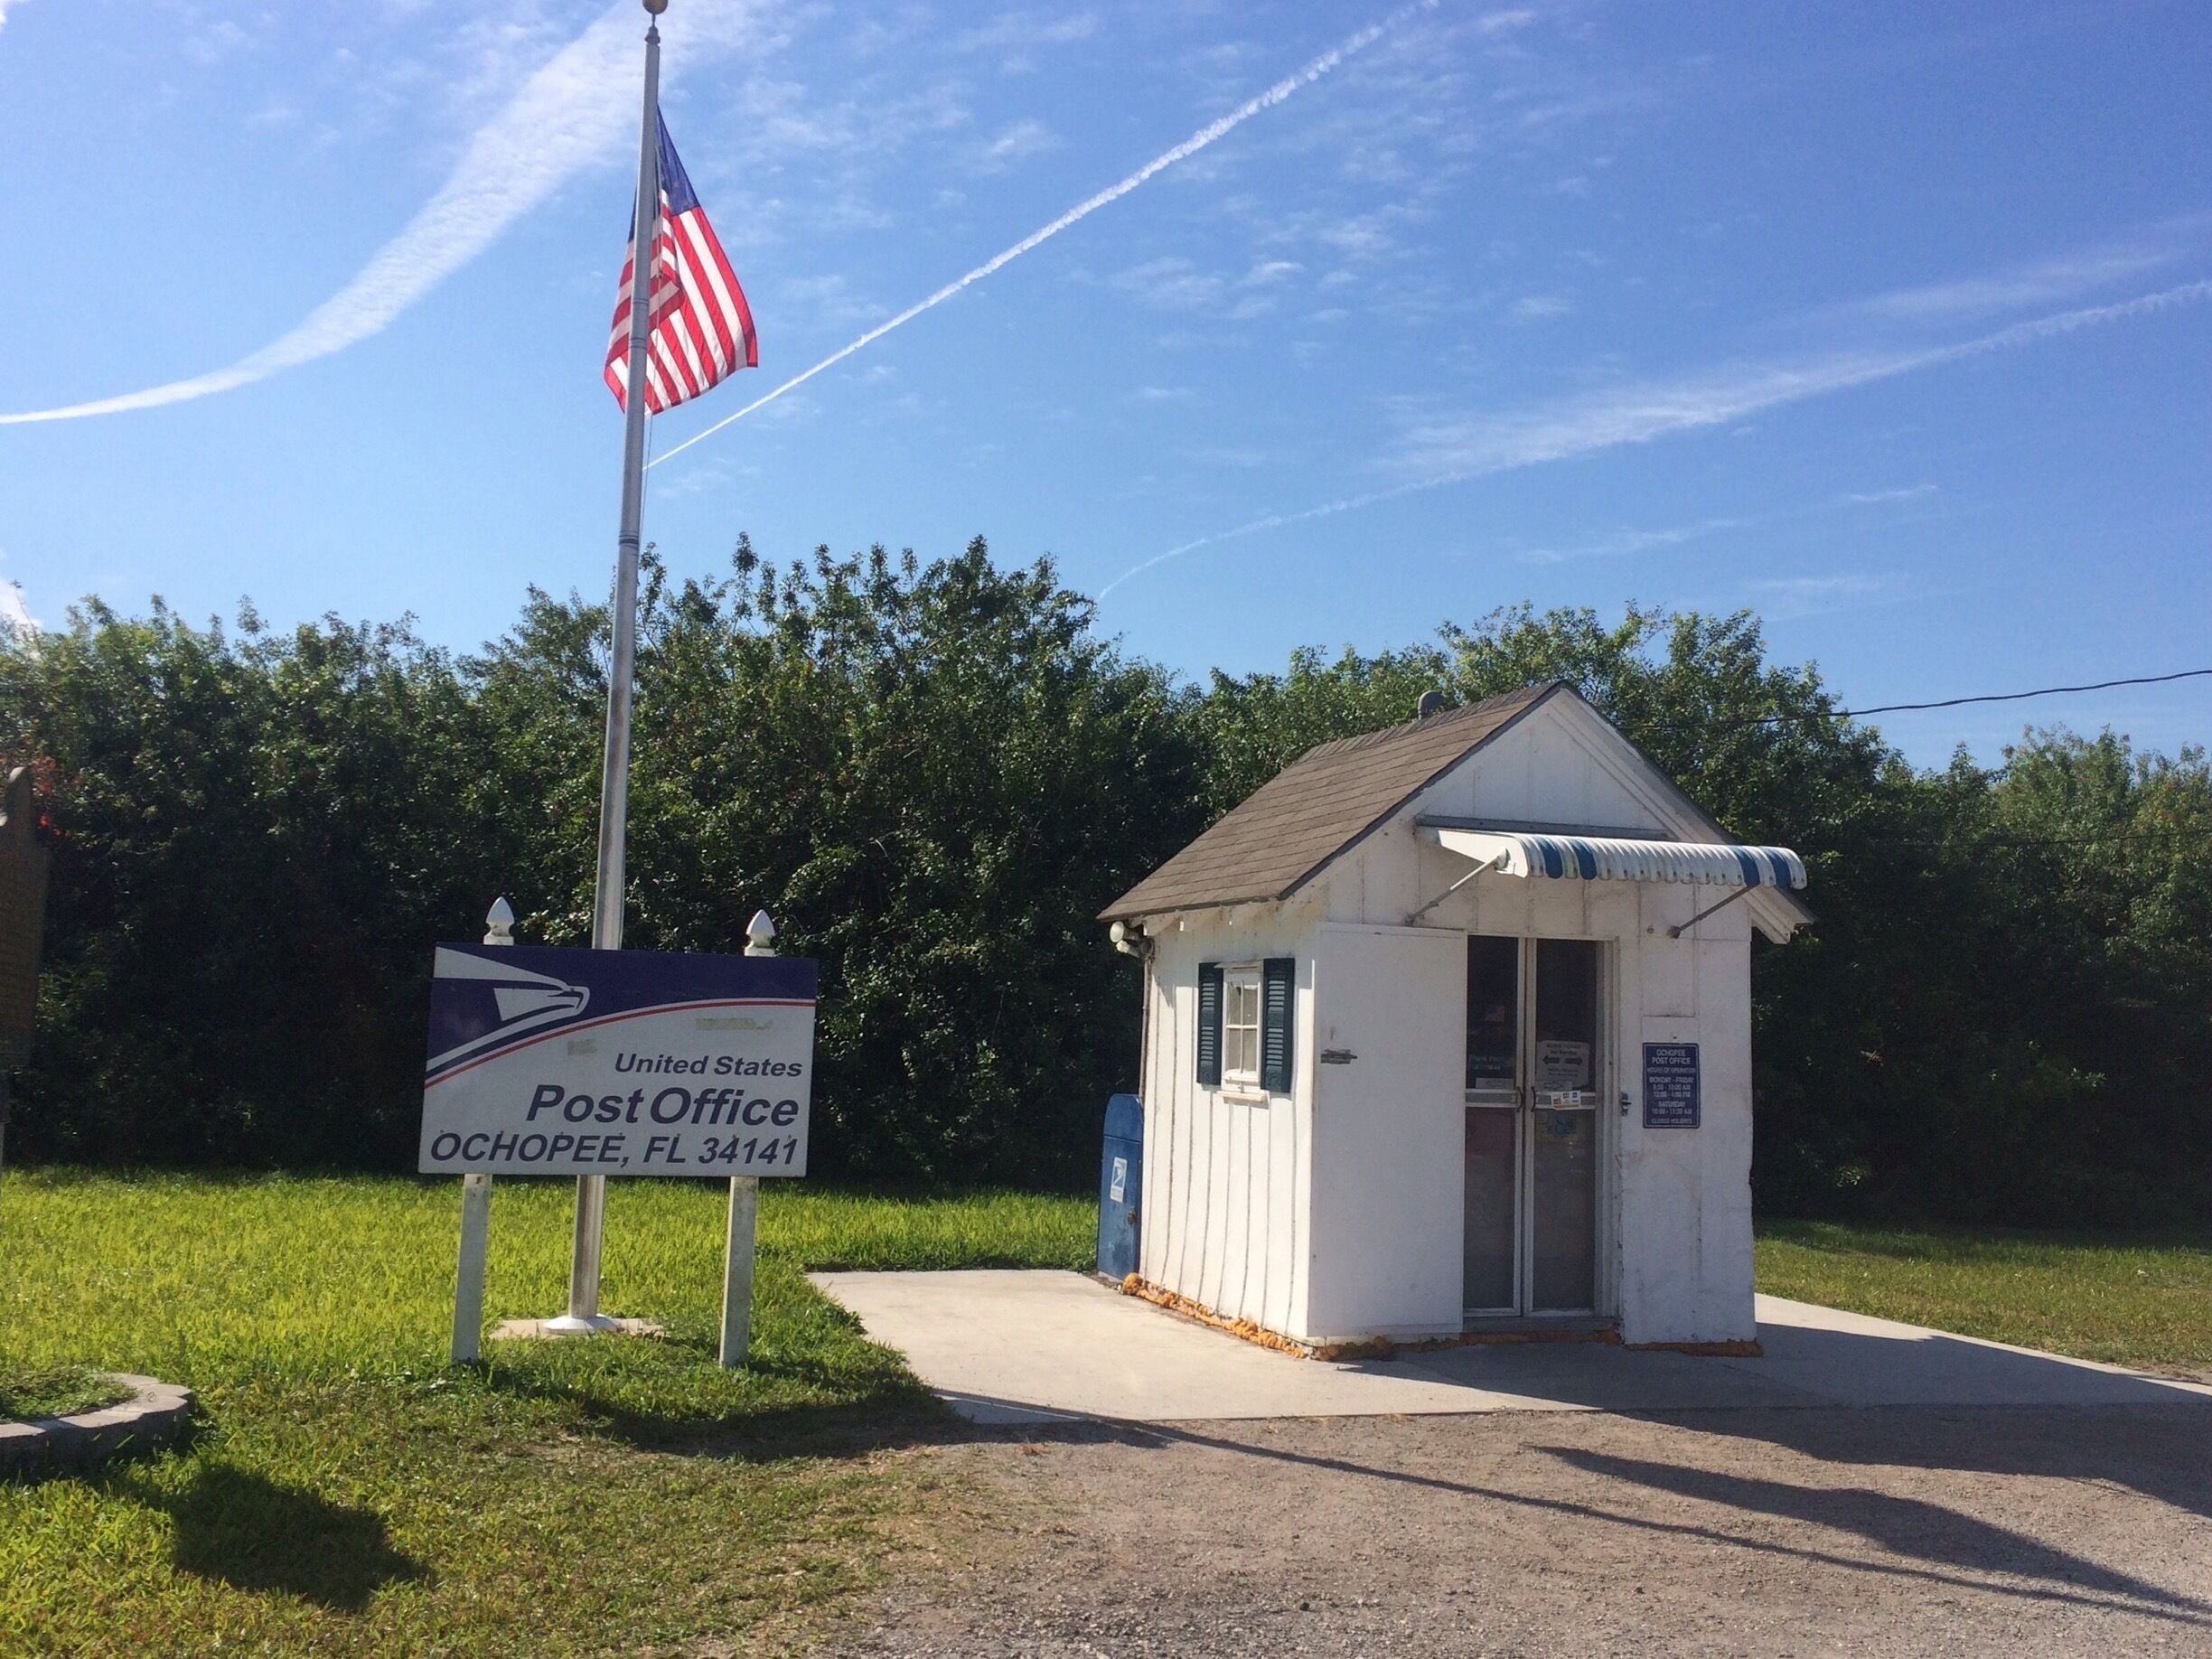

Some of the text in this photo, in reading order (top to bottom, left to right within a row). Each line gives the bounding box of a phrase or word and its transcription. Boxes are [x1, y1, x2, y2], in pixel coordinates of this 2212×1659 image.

[1652, 1056, 1692, 1064] POST OFFICE
[1656, 1048, 1686, 1056] OCHOPEE
[614, 1053, 802, 1077] United States
[527, 1084, 799, 1127] Post Office
[430, 1131, 798, 1168] OCHOPEE, FL 34141
